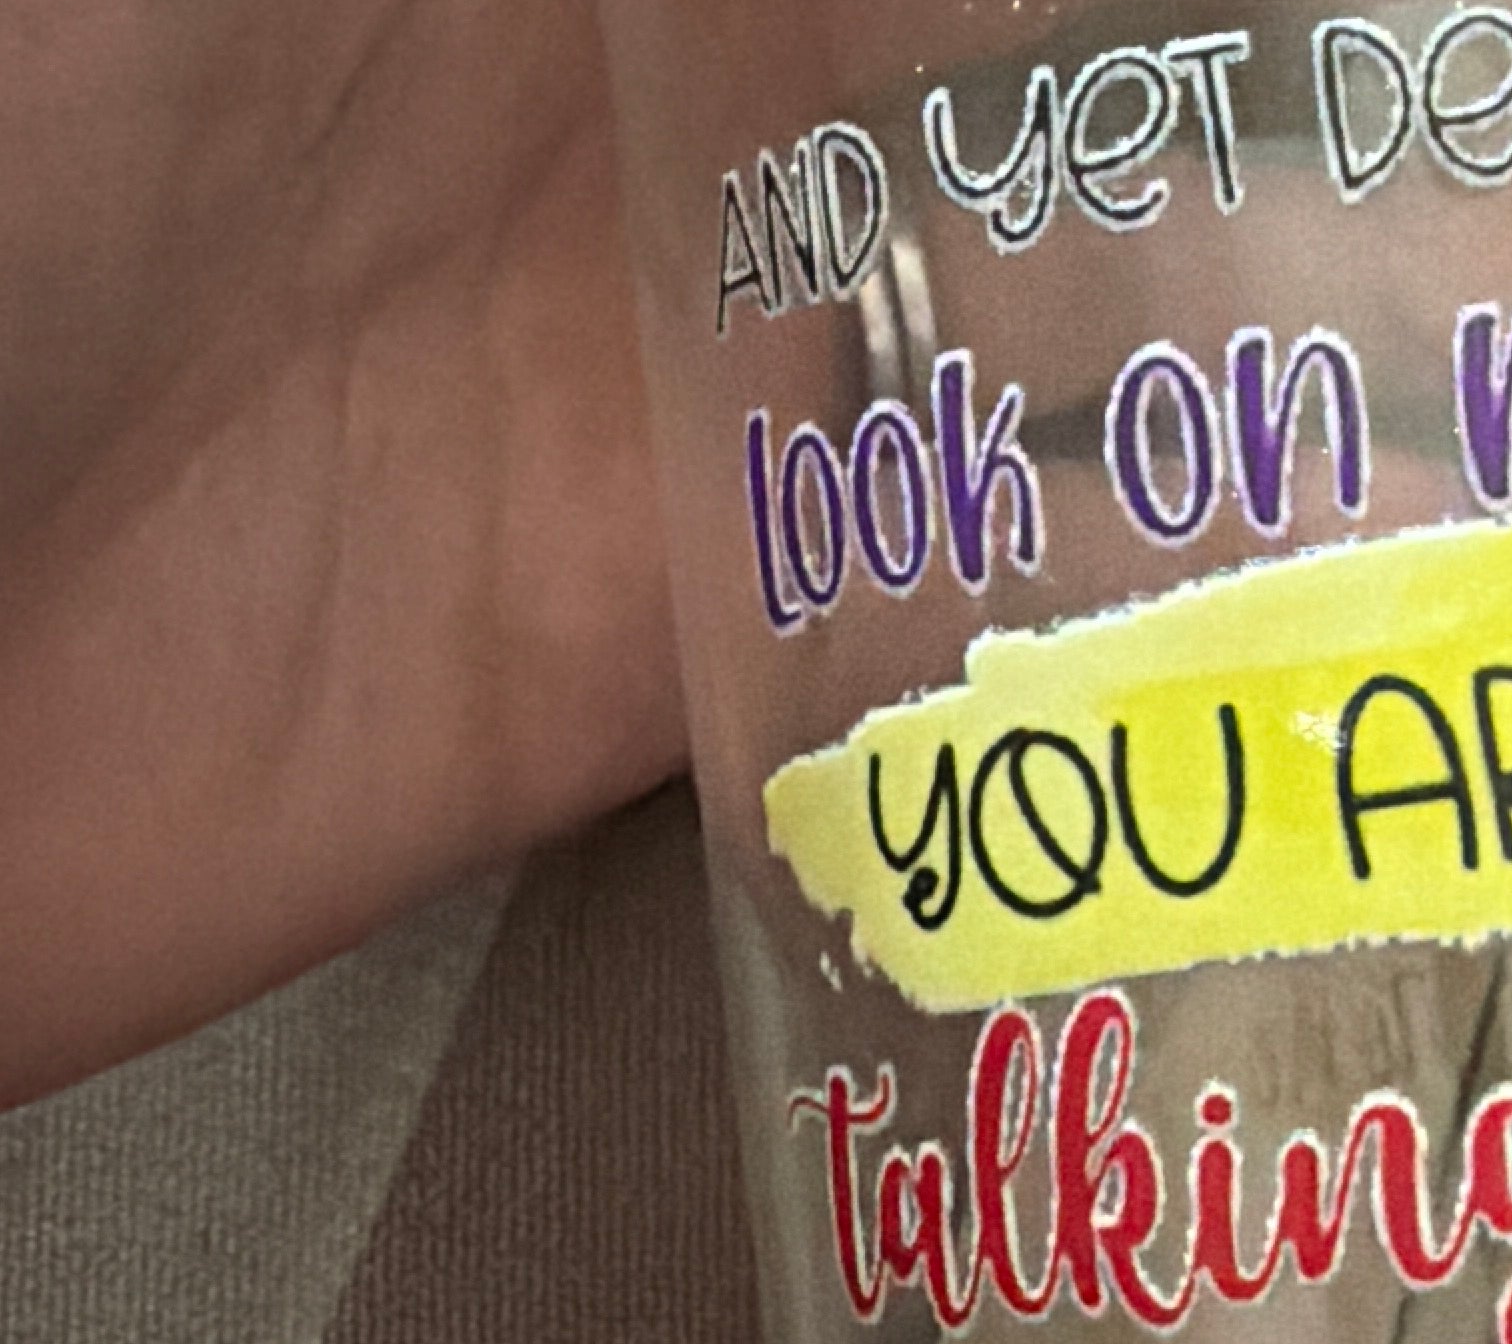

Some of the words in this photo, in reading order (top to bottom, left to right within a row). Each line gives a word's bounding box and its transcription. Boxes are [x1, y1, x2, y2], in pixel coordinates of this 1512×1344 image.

[716, 122, 888, 336] AND
[746, 349, 1045, 636] look
[1105, 326, 1372, 547] on
